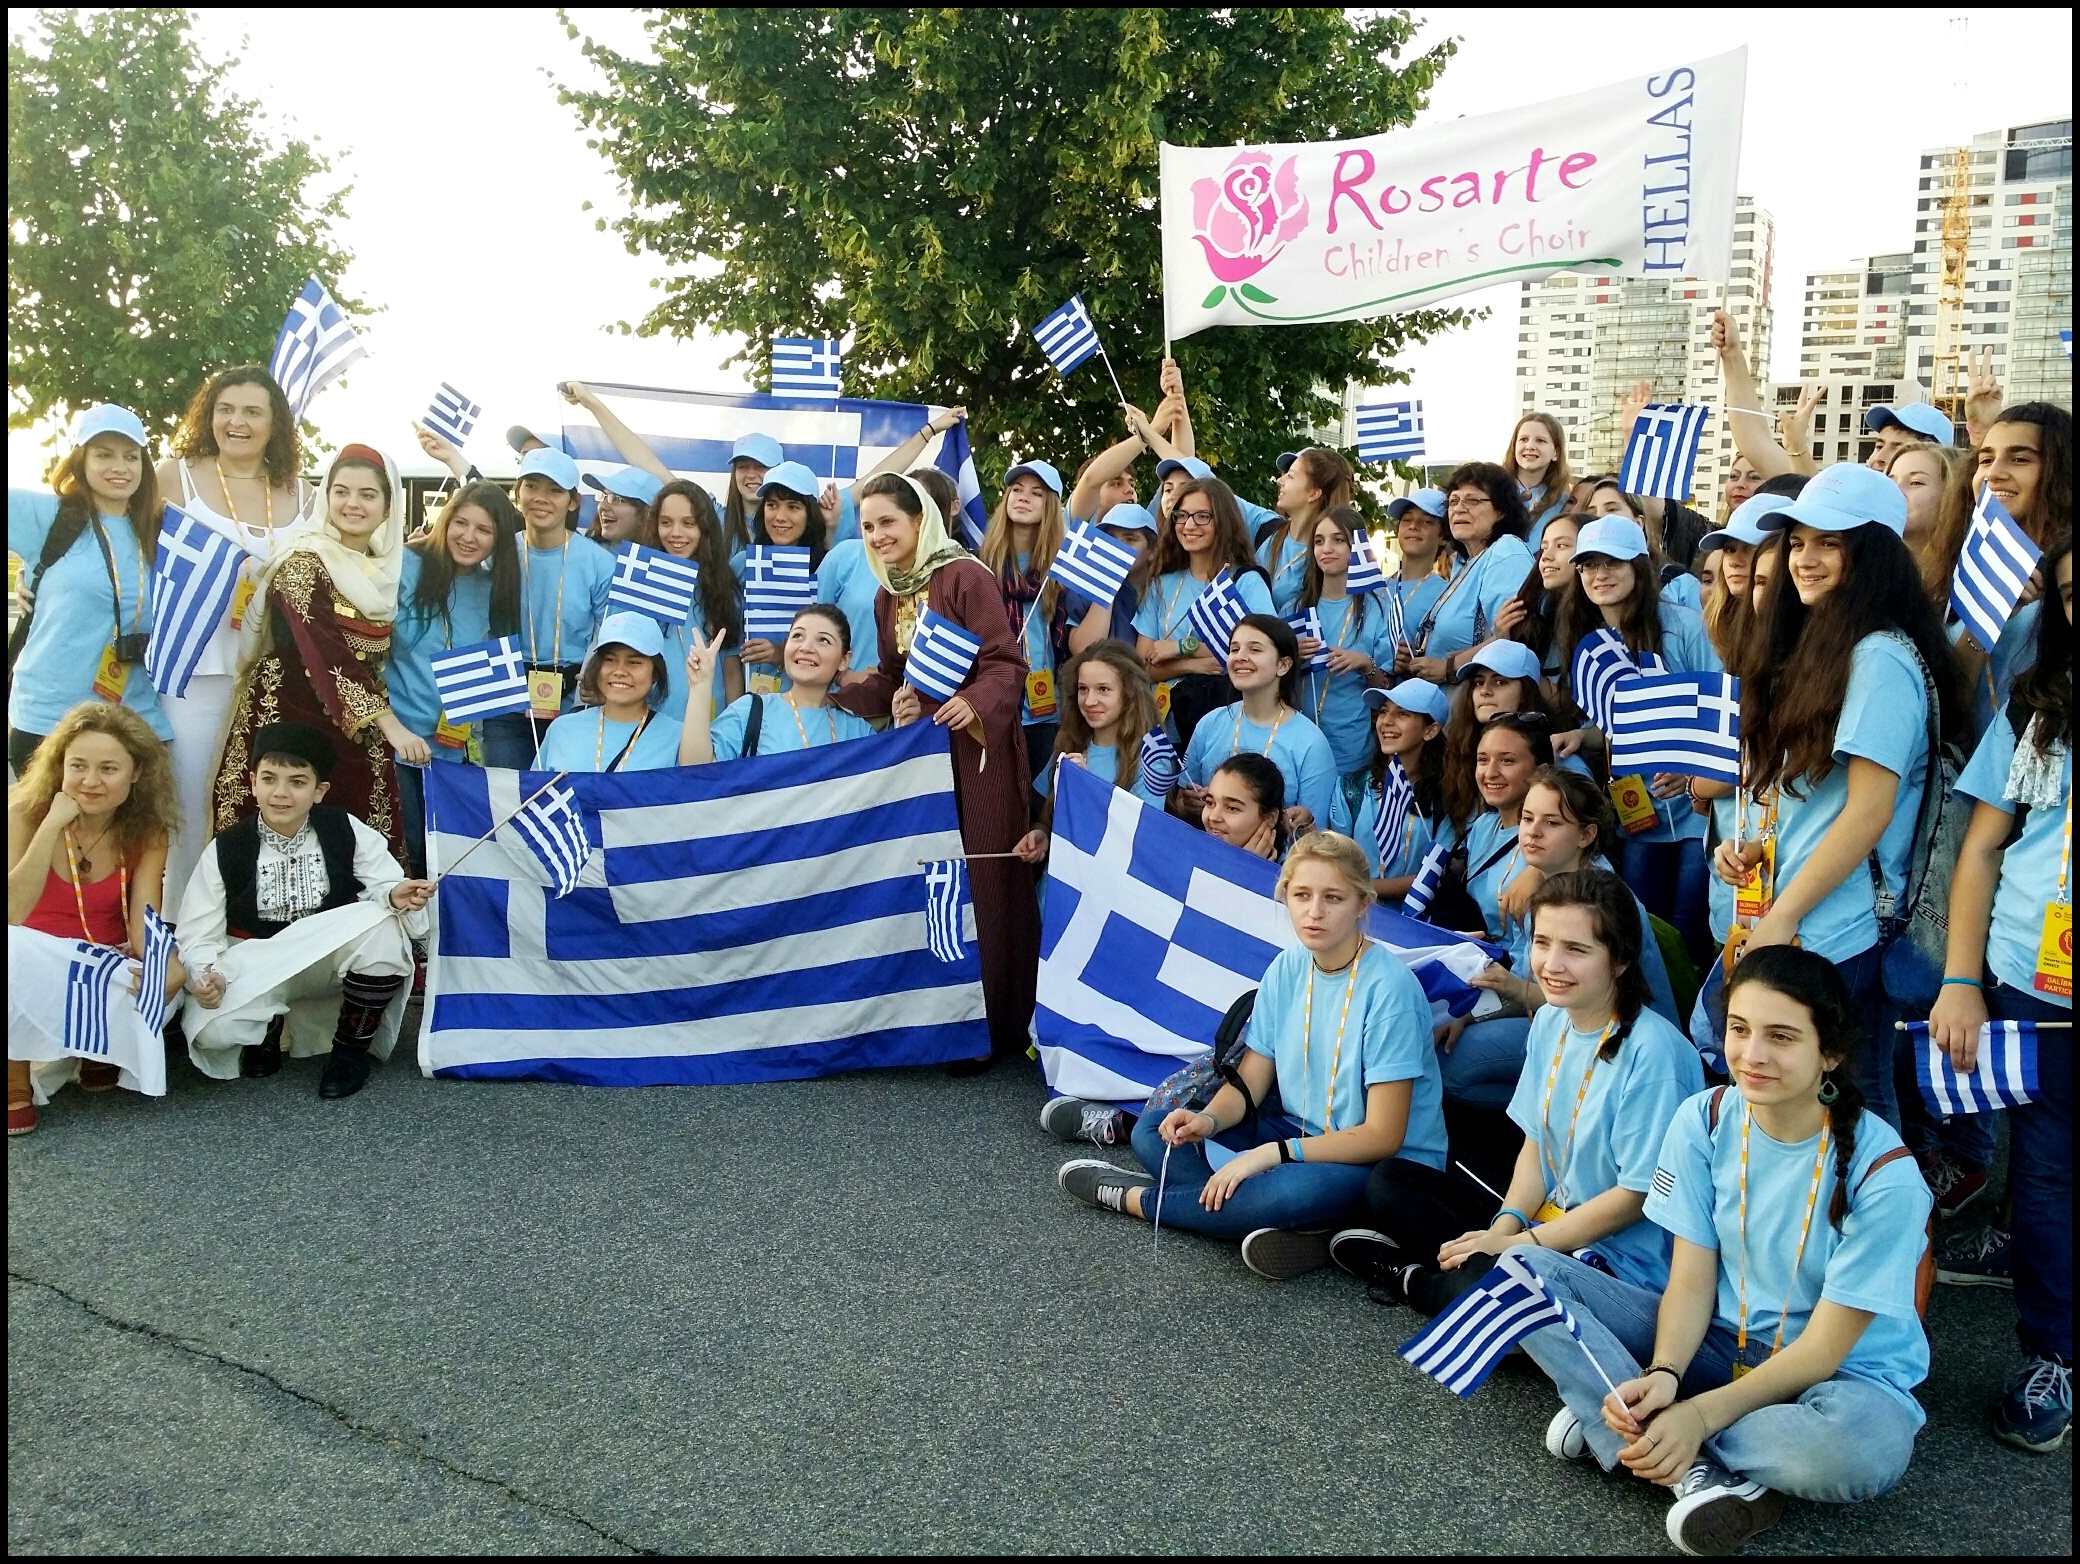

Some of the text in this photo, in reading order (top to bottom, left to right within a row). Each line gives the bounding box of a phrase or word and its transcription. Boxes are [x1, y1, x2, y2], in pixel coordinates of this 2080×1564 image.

[1327, 146, 1598, 235] Rosarte
[1643, 67, 1695, 274] HELLAS
[1498, 219, 1592, 258] Choir
